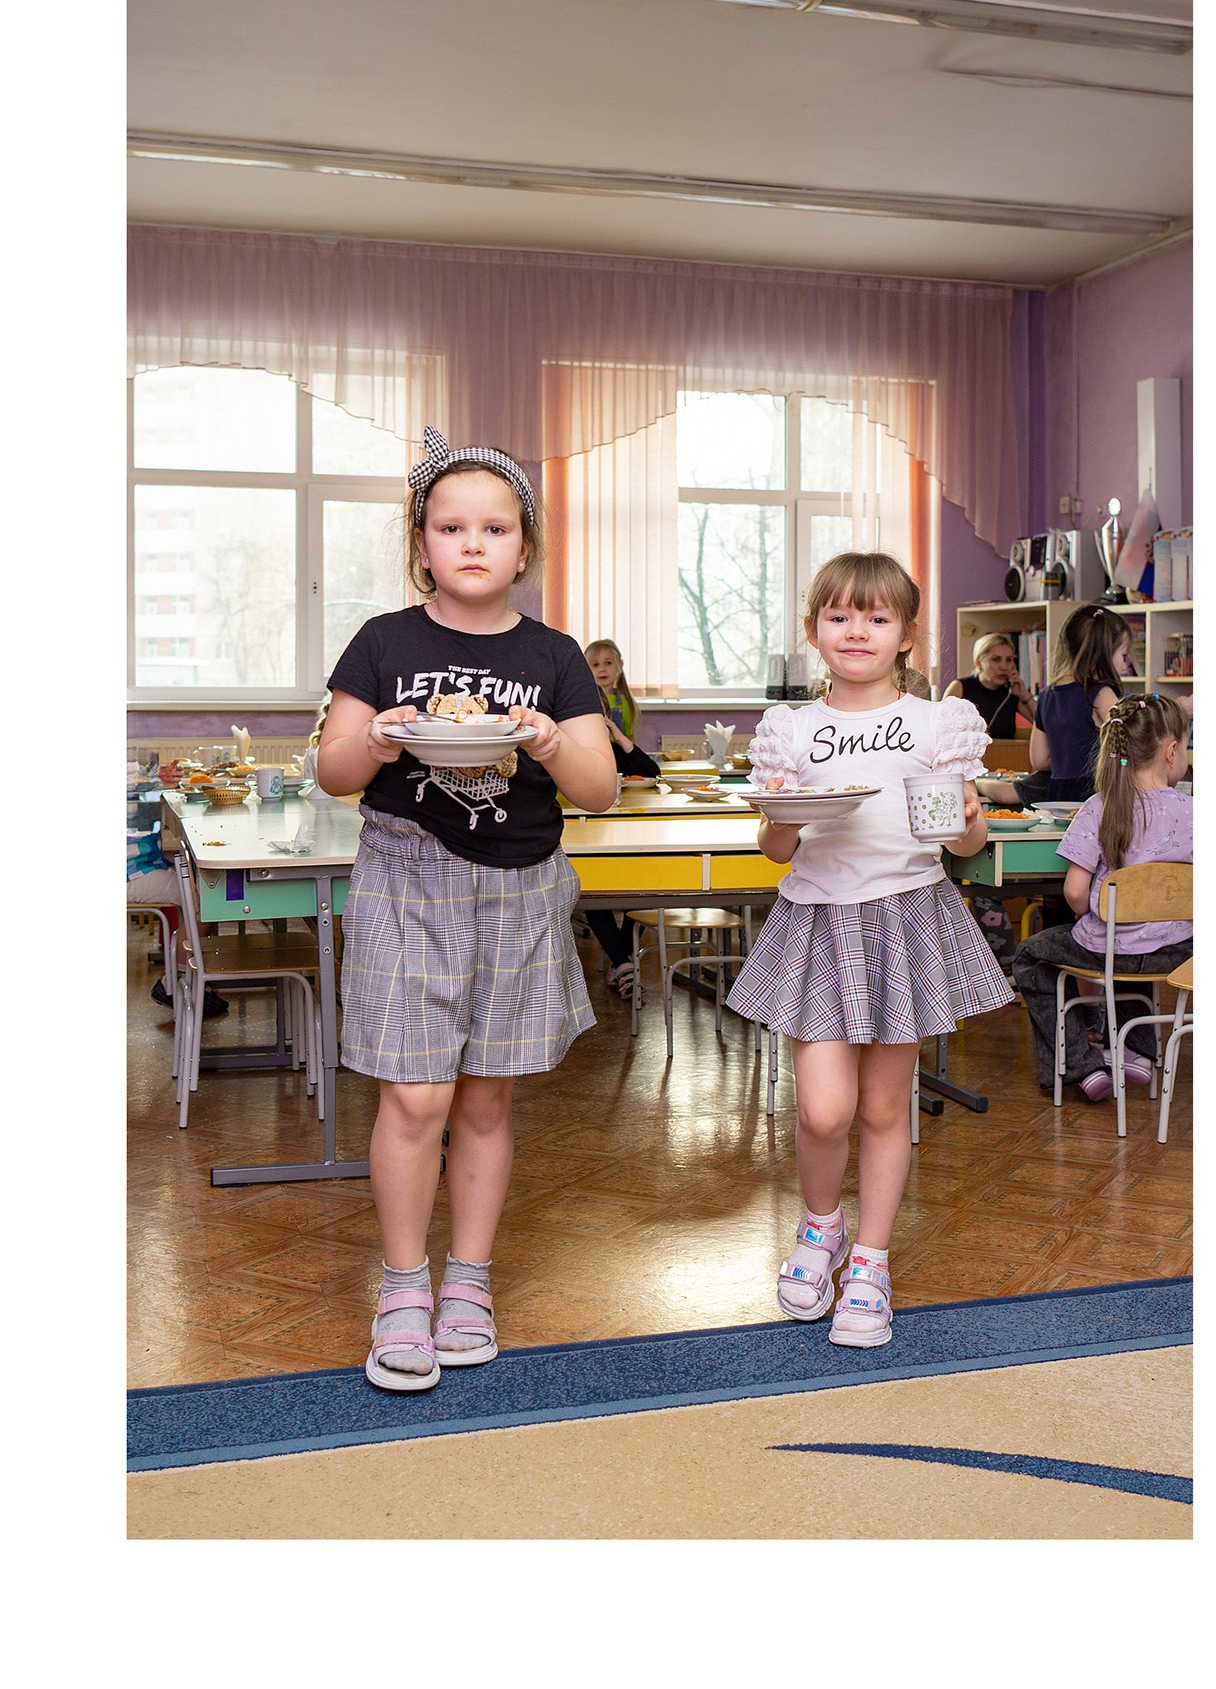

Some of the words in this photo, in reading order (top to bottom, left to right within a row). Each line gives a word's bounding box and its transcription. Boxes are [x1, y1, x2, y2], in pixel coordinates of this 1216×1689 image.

[396, 671, 473, 704] LET'S
[478, 676, 541, 712] FUN!
[810, 716, 915, 764] Smile
